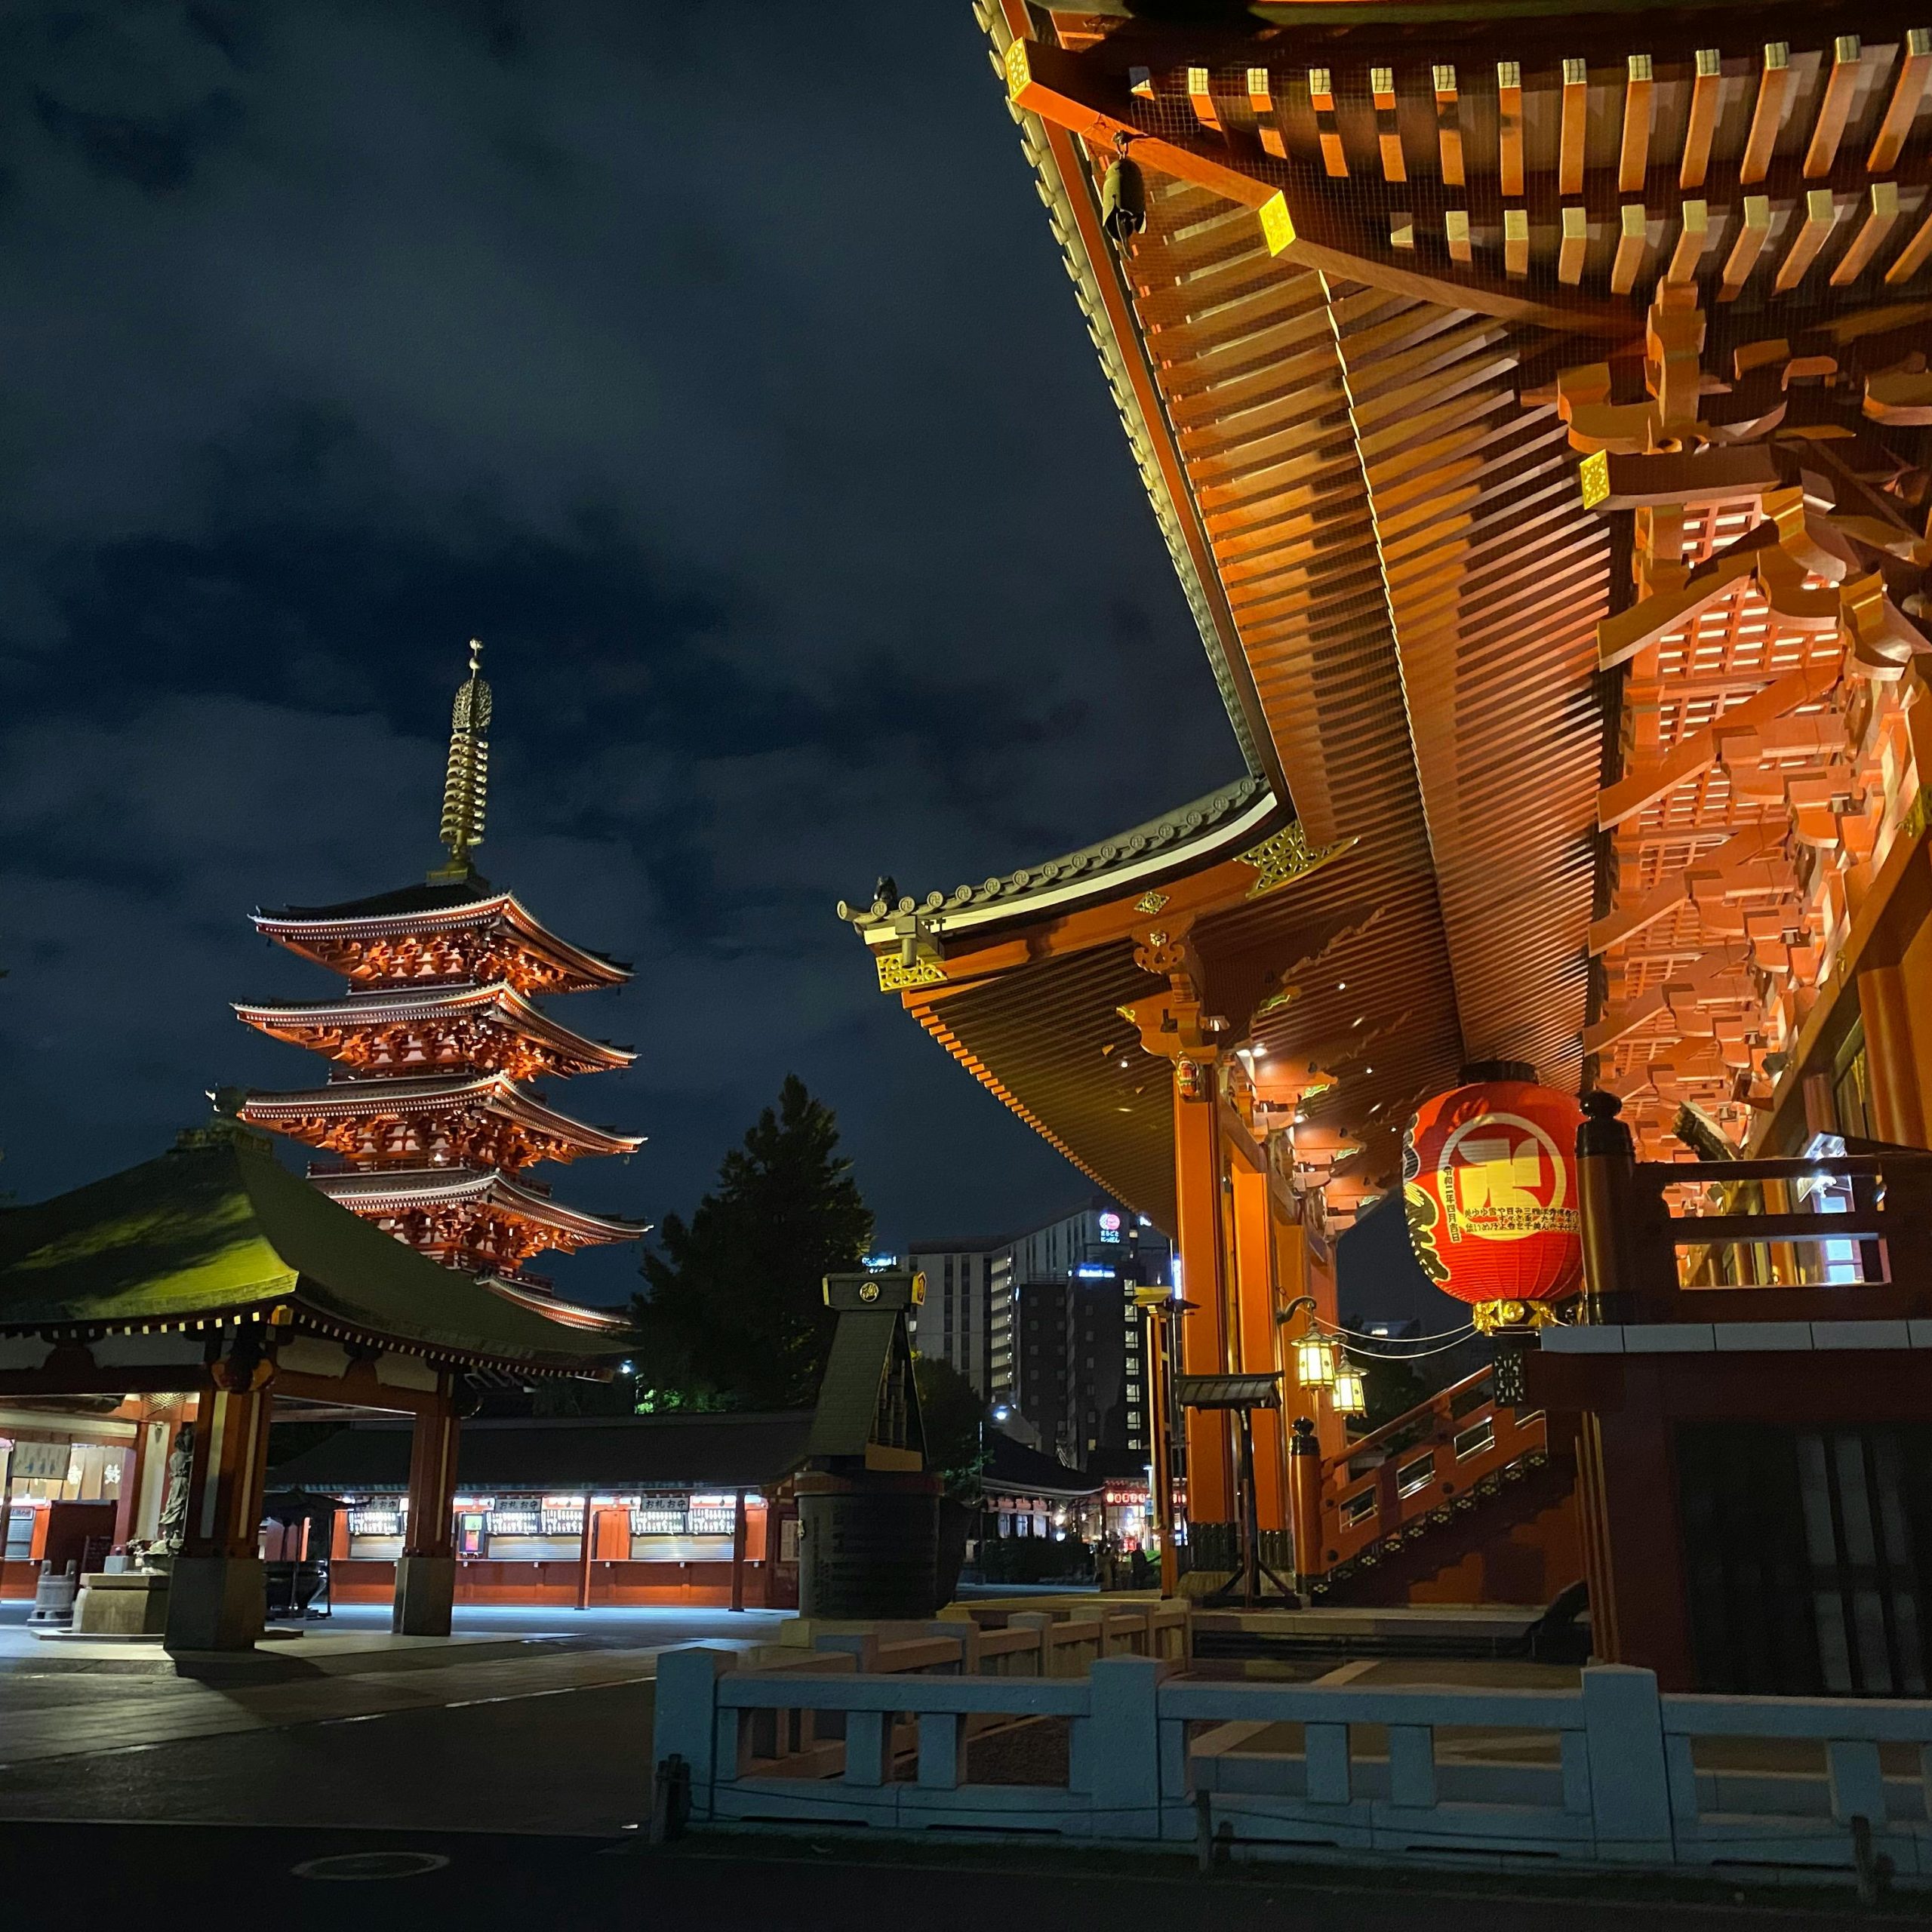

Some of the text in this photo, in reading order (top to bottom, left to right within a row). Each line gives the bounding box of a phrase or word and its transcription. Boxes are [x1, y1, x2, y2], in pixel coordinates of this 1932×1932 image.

[1443, 1166, 1460, 1241] 令和二年四月吉日
[645, 1499, 686, 1509] お札お守
